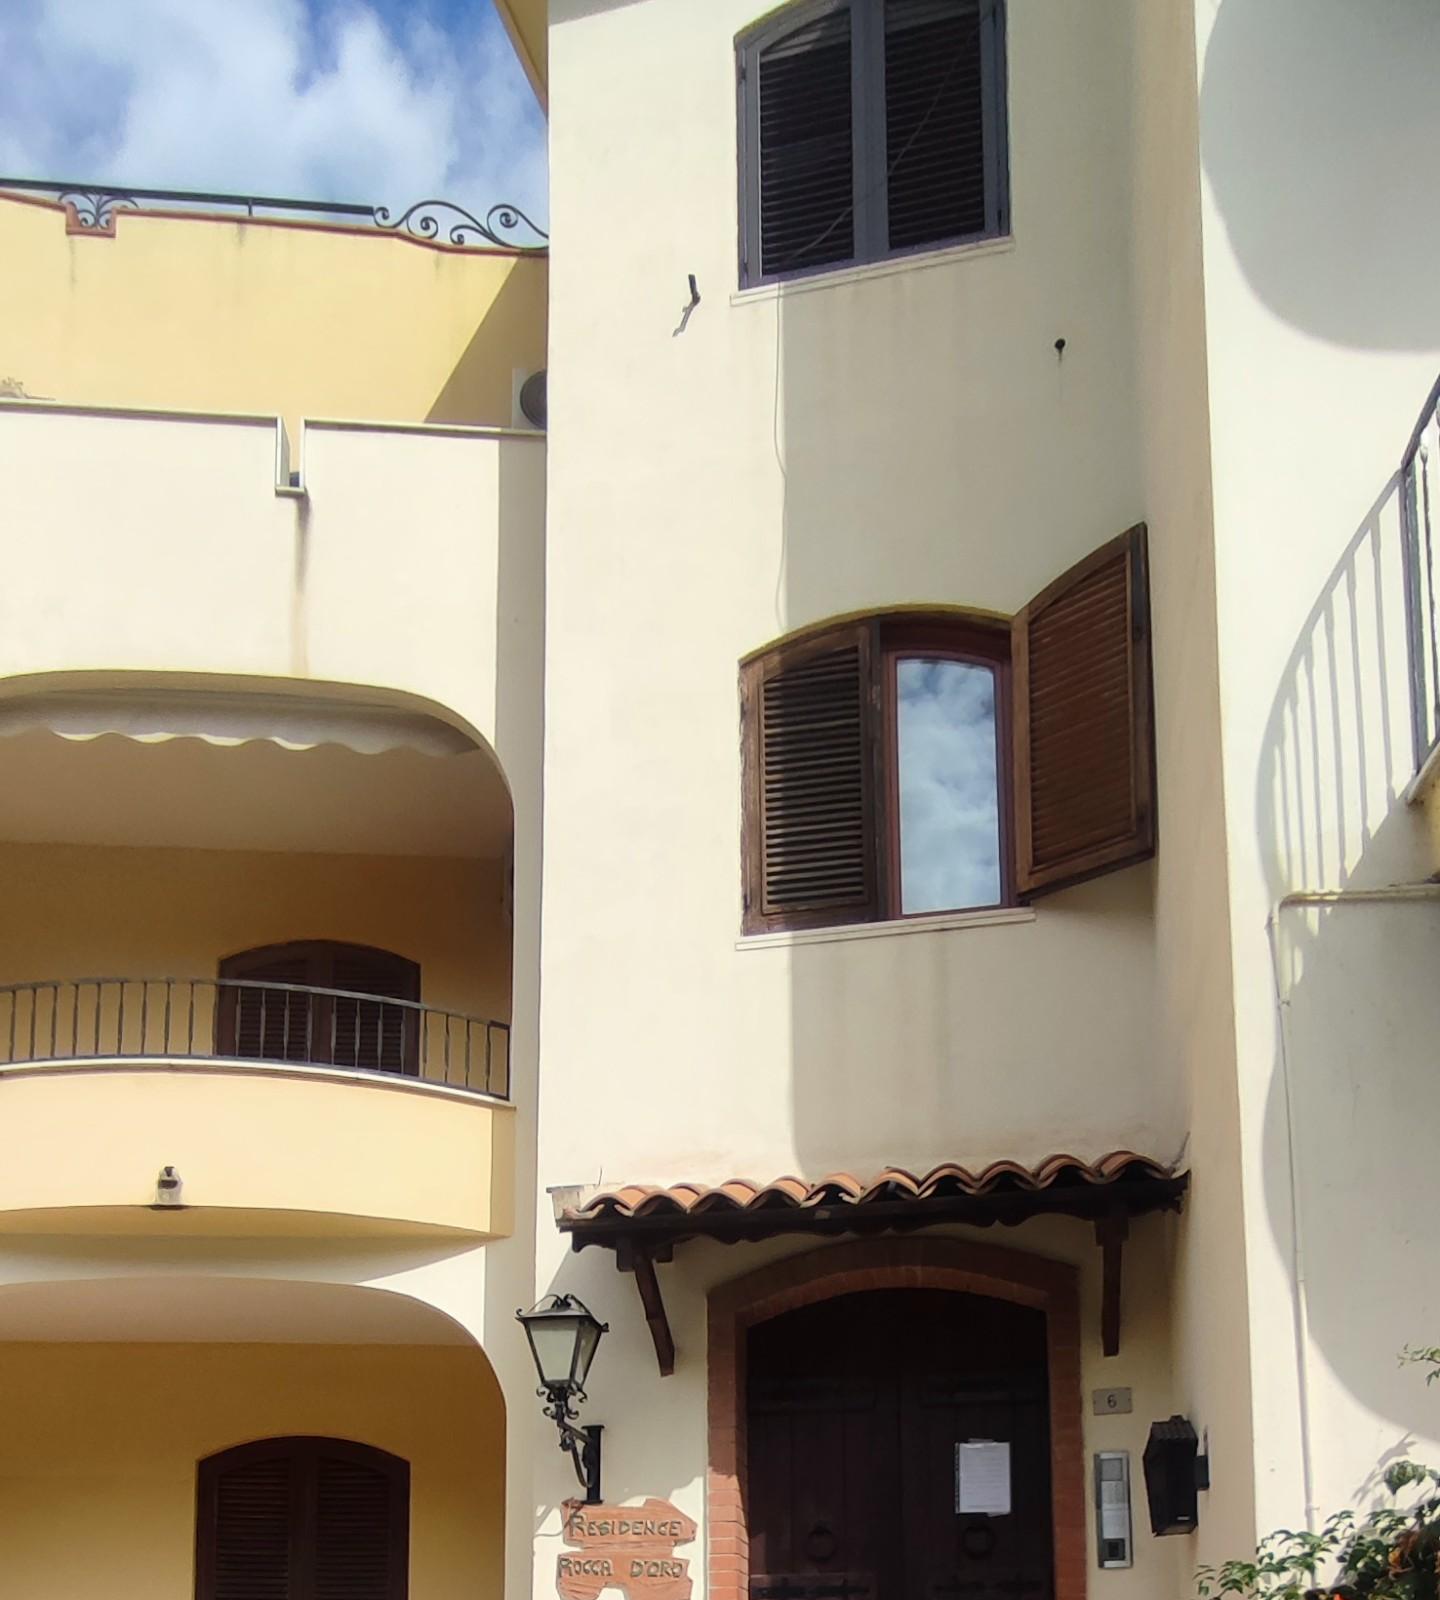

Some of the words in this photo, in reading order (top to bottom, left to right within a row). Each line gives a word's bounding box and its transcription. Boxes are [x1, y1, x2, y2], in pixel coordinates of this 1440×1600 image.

[1107, 1394, 1117, 1409] 6
[569, 1512, 682, 1537] RESIDENCE
[558, 1557, 613, 1578] ROCCA
[630, 1560, 683, 1578] D'ORO
